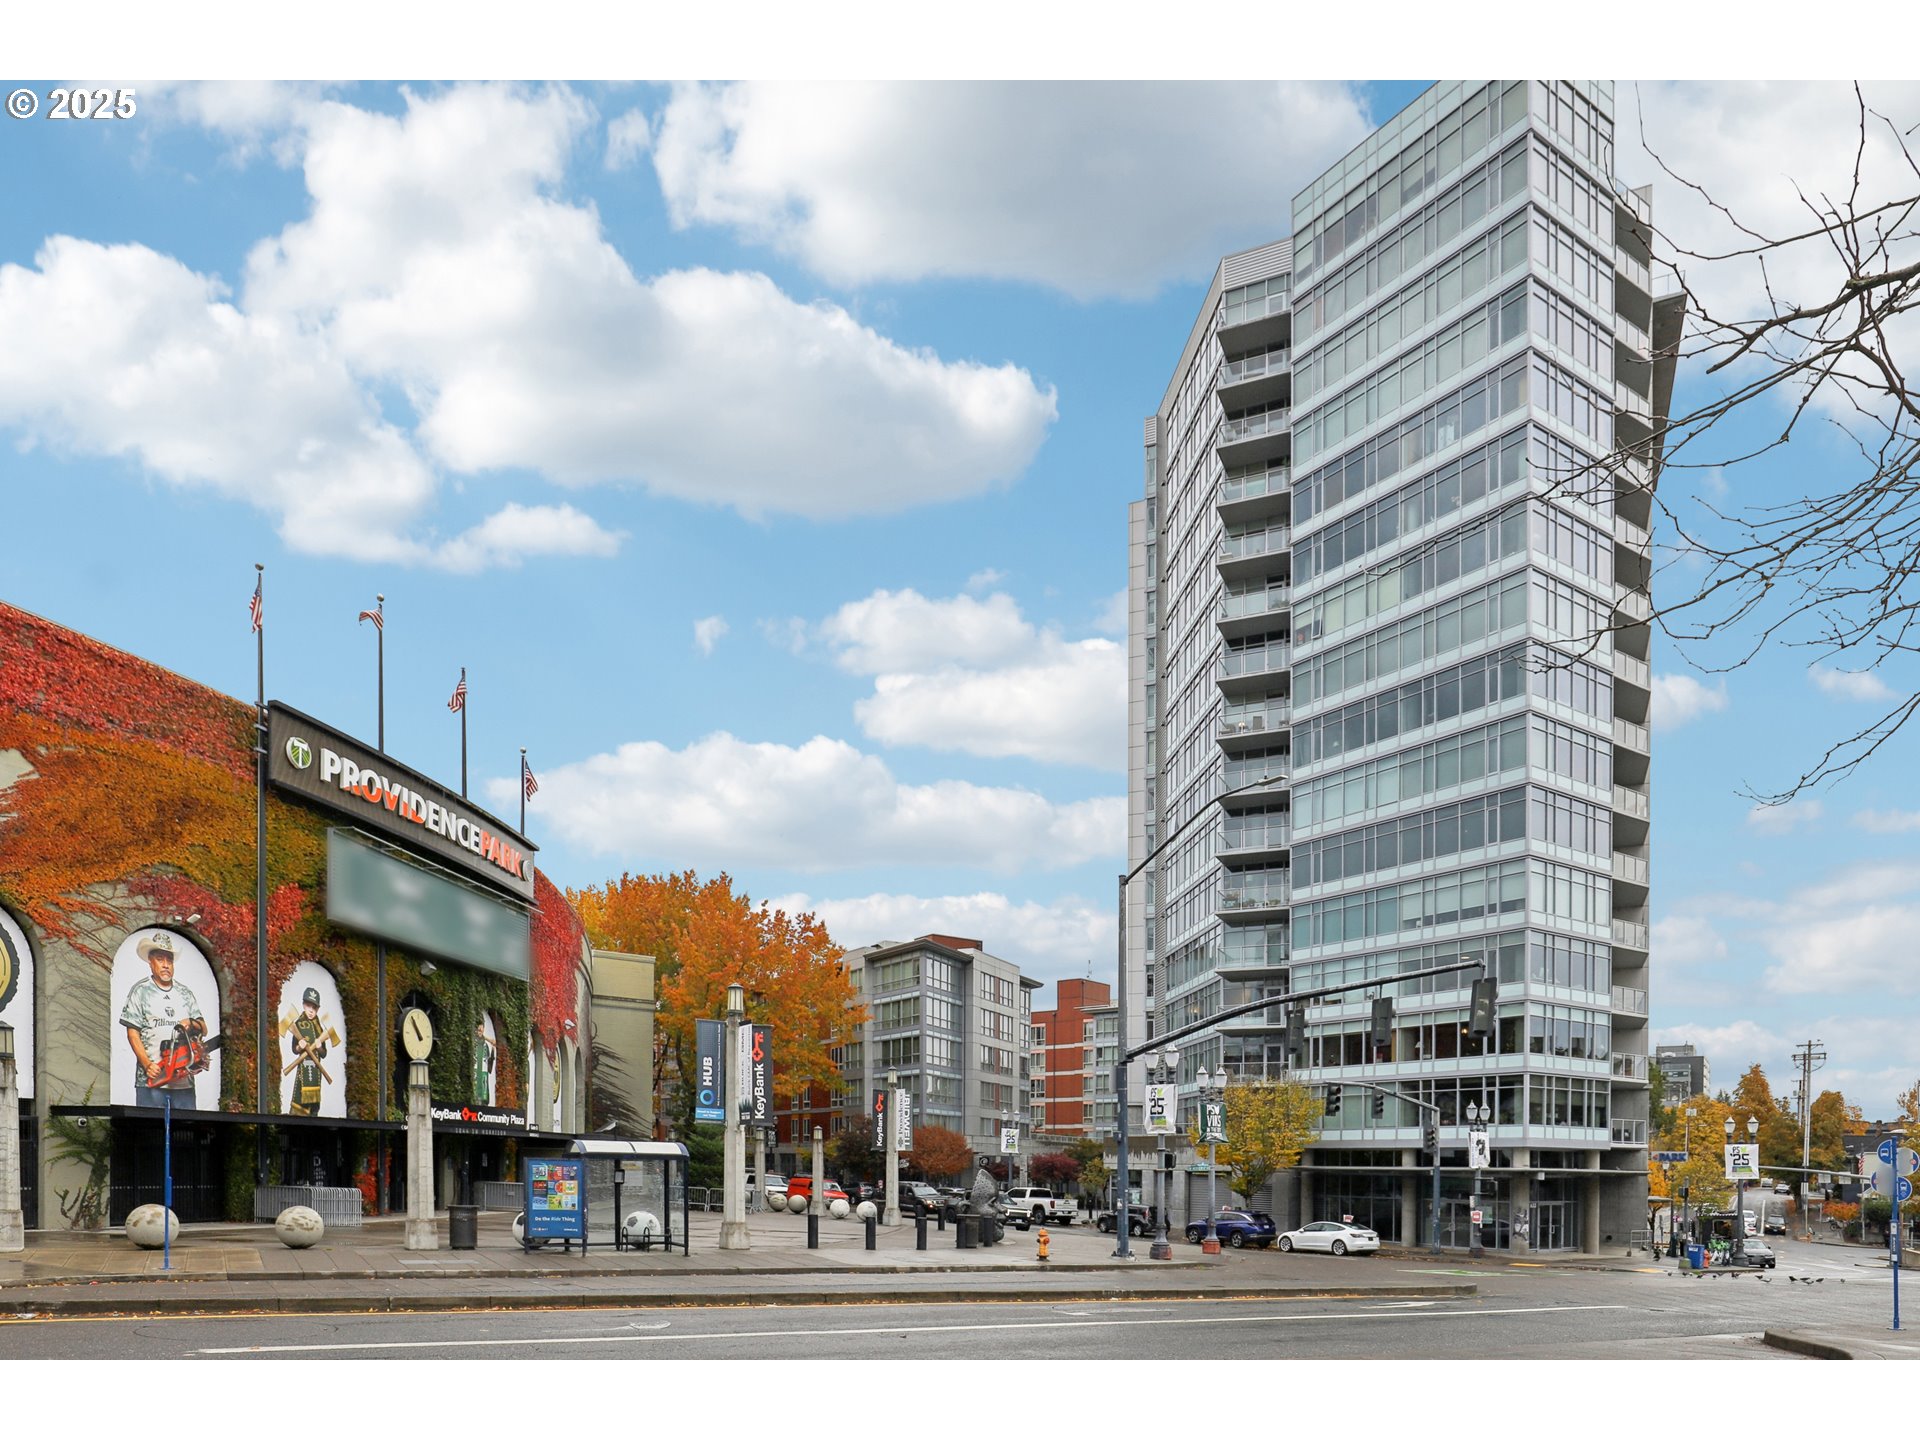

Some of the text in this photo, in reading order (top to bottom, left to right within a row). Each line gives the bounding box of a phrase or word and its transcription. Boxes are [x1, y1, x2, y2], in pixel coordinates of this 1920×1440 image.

[319, 748, 523, 878] PROVIDENCE PARK
[703, 1056, 713, 1086] HUB
[754, 1063, 767, 1120] KeyBank
[431, 1107, 525, 1126] KeyBank Community Plaza
[876, 1113, 884, 1146] KeyBank
[1658, 1152, 1687, 1162] PARK
